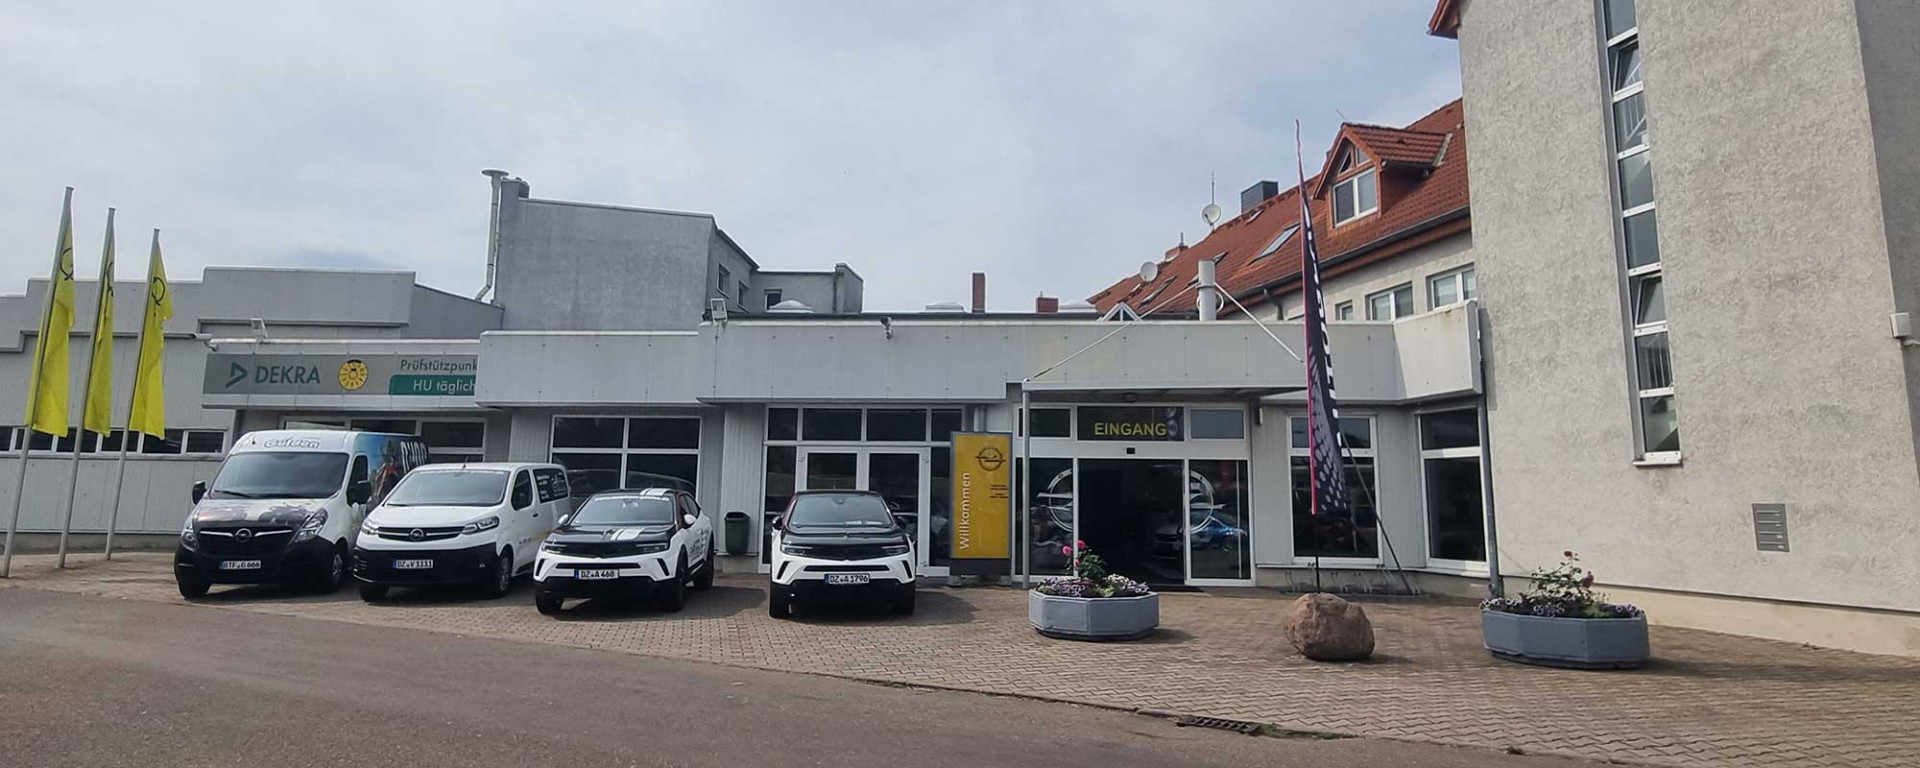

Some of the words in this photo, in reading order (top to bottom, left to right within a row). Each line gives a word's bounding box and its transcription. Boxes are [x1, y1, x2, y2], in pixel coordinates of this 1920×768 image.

[255, 366, 320, 384] DEKRA
[413, 380, 432, 391] HU
[436, 379, 475, 394] täglich
[1094, 422, 1167, 436] EINGANG
[959, 472, 971, 550] Willkommen
